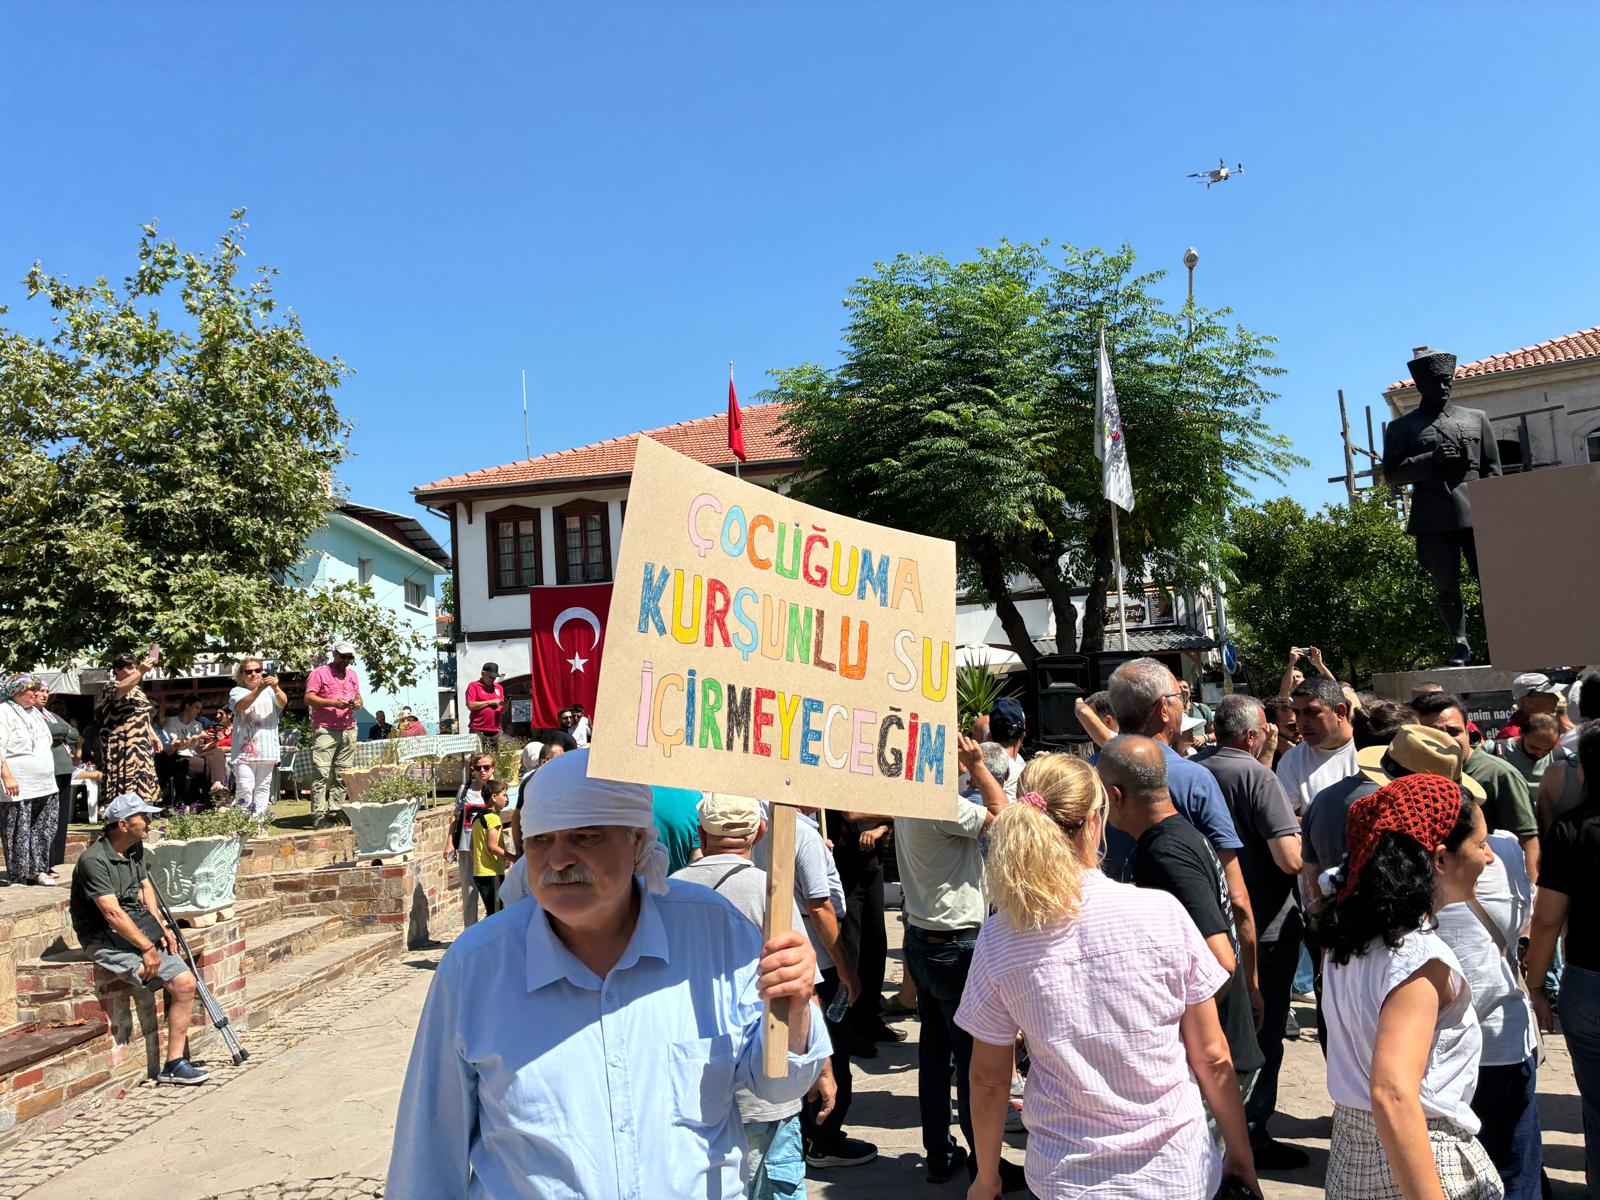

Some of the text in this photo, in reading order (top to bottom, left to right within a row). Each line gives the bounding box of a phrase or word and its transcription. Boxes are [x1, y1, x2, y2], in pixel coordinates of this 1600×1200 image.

[687, 493, 924, 613] ÇOCUĞUMA
[638, 562, 950, 702] KURŞUNLU SU
[635, 660, 946, 785] İÇİRMEYECEĞİM
[1467, 709, 1491, 721] enim
